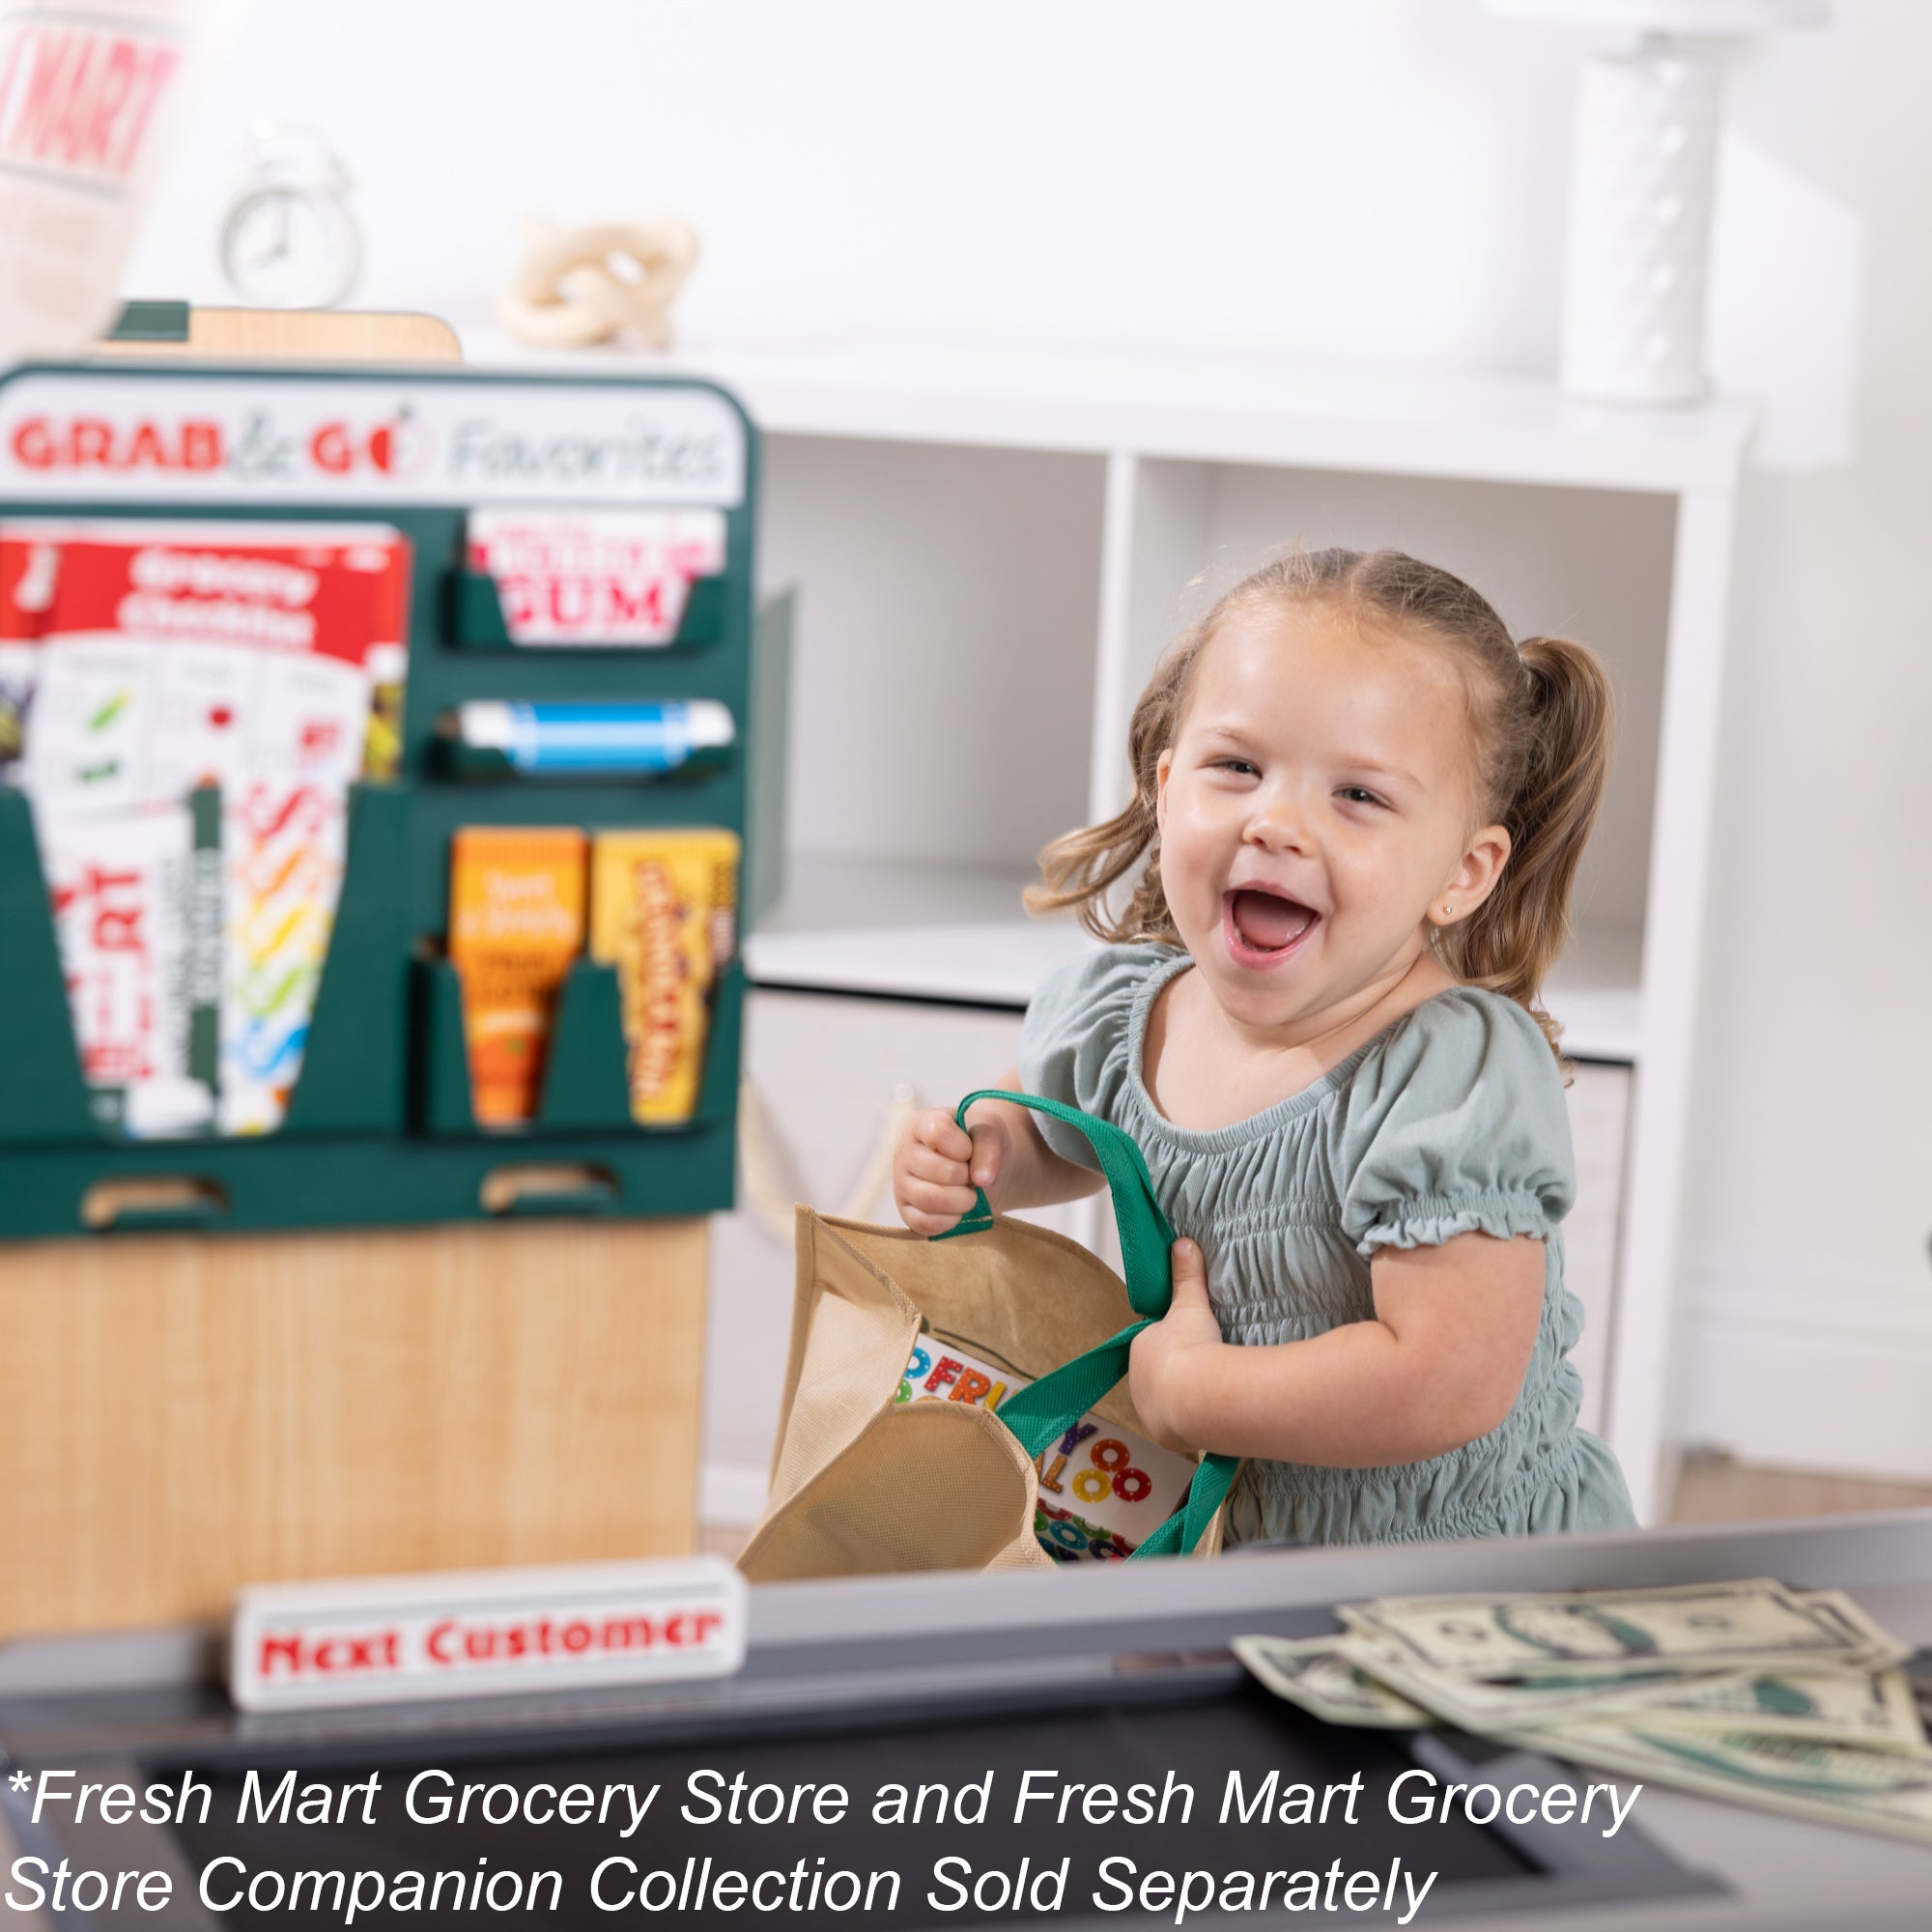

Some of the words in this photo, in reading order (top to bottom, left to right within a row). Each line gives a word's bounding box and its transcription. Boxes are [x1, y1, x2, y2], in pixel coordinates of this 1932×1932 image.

[10, 418, 227, 472] GRAB
[449, 413, 726, 481] Favorites
[258, 1630, 400, 1677] Next
[426, 1610, 723, 1664] Customer
